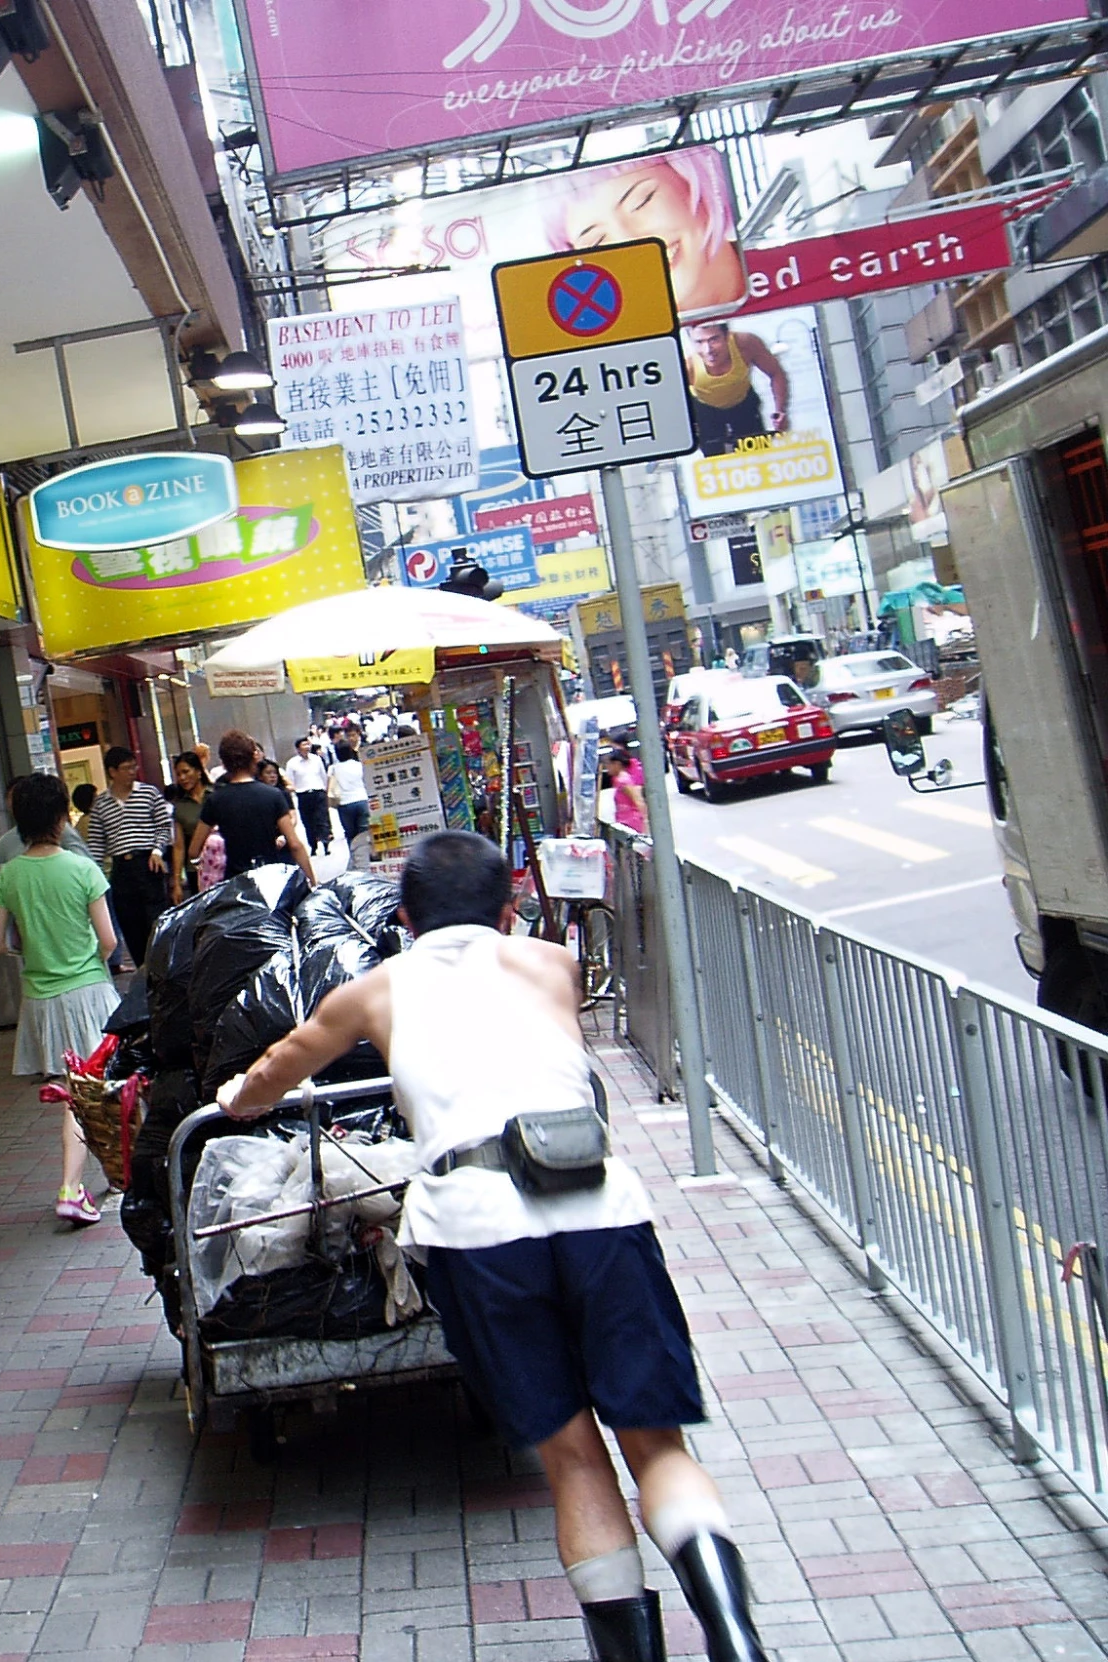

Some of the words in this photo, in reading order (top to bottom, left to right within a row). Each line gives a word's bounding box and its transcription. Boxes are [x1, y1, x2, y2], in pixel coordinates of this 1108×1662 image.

[443, 57, 611, 118] everyone's
[611, 29, 751, 99] pinking
[758, 5, 853, 53] about
[858, 9, 903, 32] us
[748, 256, 801, 298] ed
[830, 233, 964, 282] earth
[279, 313, 376, 346] BASEMENT
[388, 309, 410, 331] TO
[421, 303, 457, 327] LET
[281, 351, 313, 369] 4000
[283, 369, 381, 413] 直接業主
[534, 367, 589, 403] 24
[600, 361, 662, 392] hrs
[556, 401, 656, 457] 全日
[734, 434, 772, 453] JOIN
[364, 463, 444, 491] PROPERTIES
[701, 466, 763, 494] 3106
[767, 455, 828, 484] 3000
[438, 534, 525, 564] POMISE
